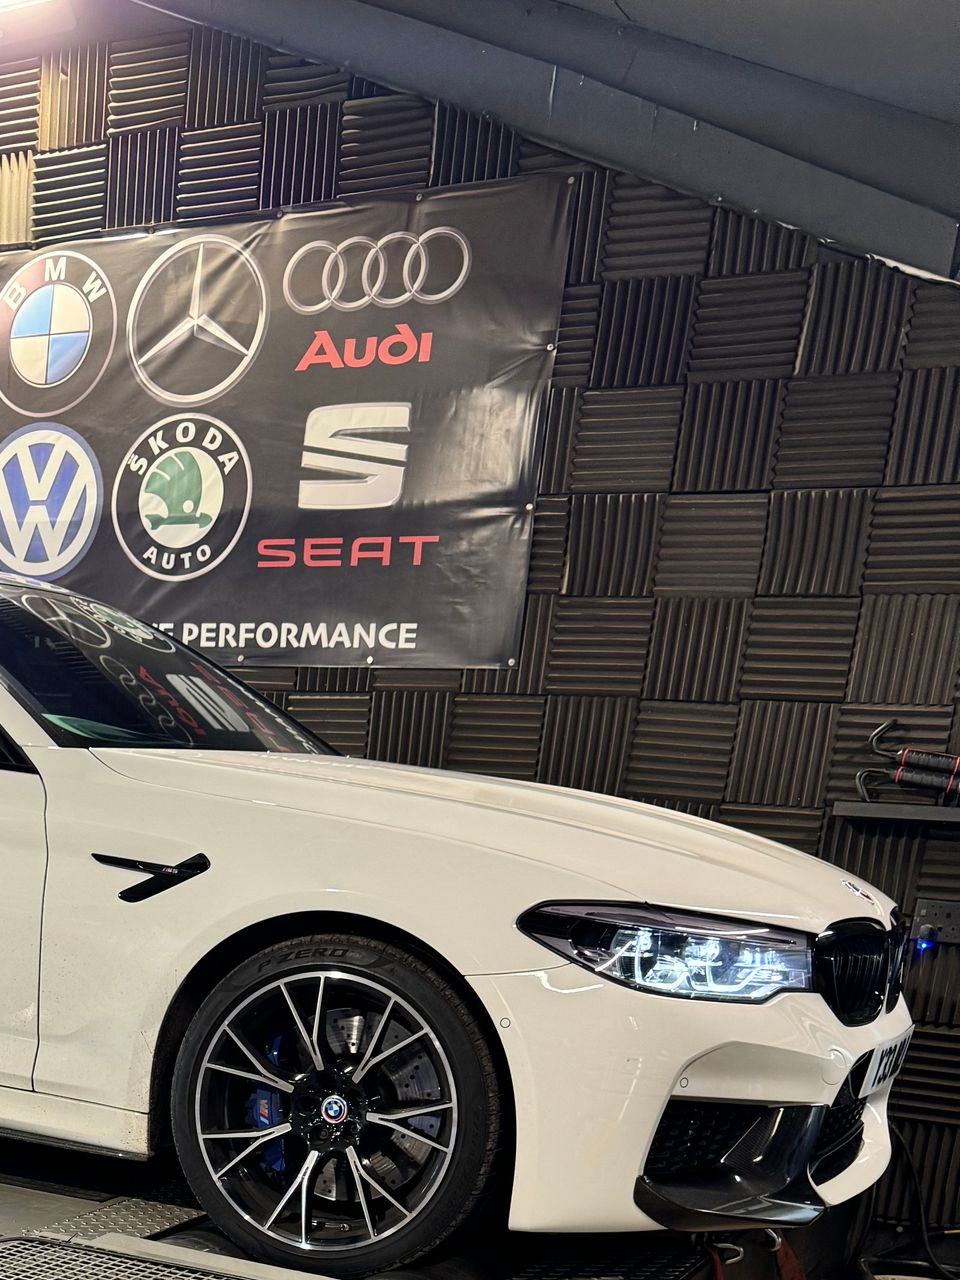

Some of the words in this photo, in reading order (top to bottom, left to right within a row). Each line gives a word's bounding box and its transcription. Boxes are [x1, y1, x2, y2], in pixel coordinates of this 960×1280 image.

[3, 256, 107, 311] BMW
[294, 324, 433, 372] Audi
[142, 543, 212, 570] AUTO
[257, 535, 439, 568] SEAT
[182, 622, 418, 648] PERFORMANCE
[278, 947, 348, 964] ZERO
